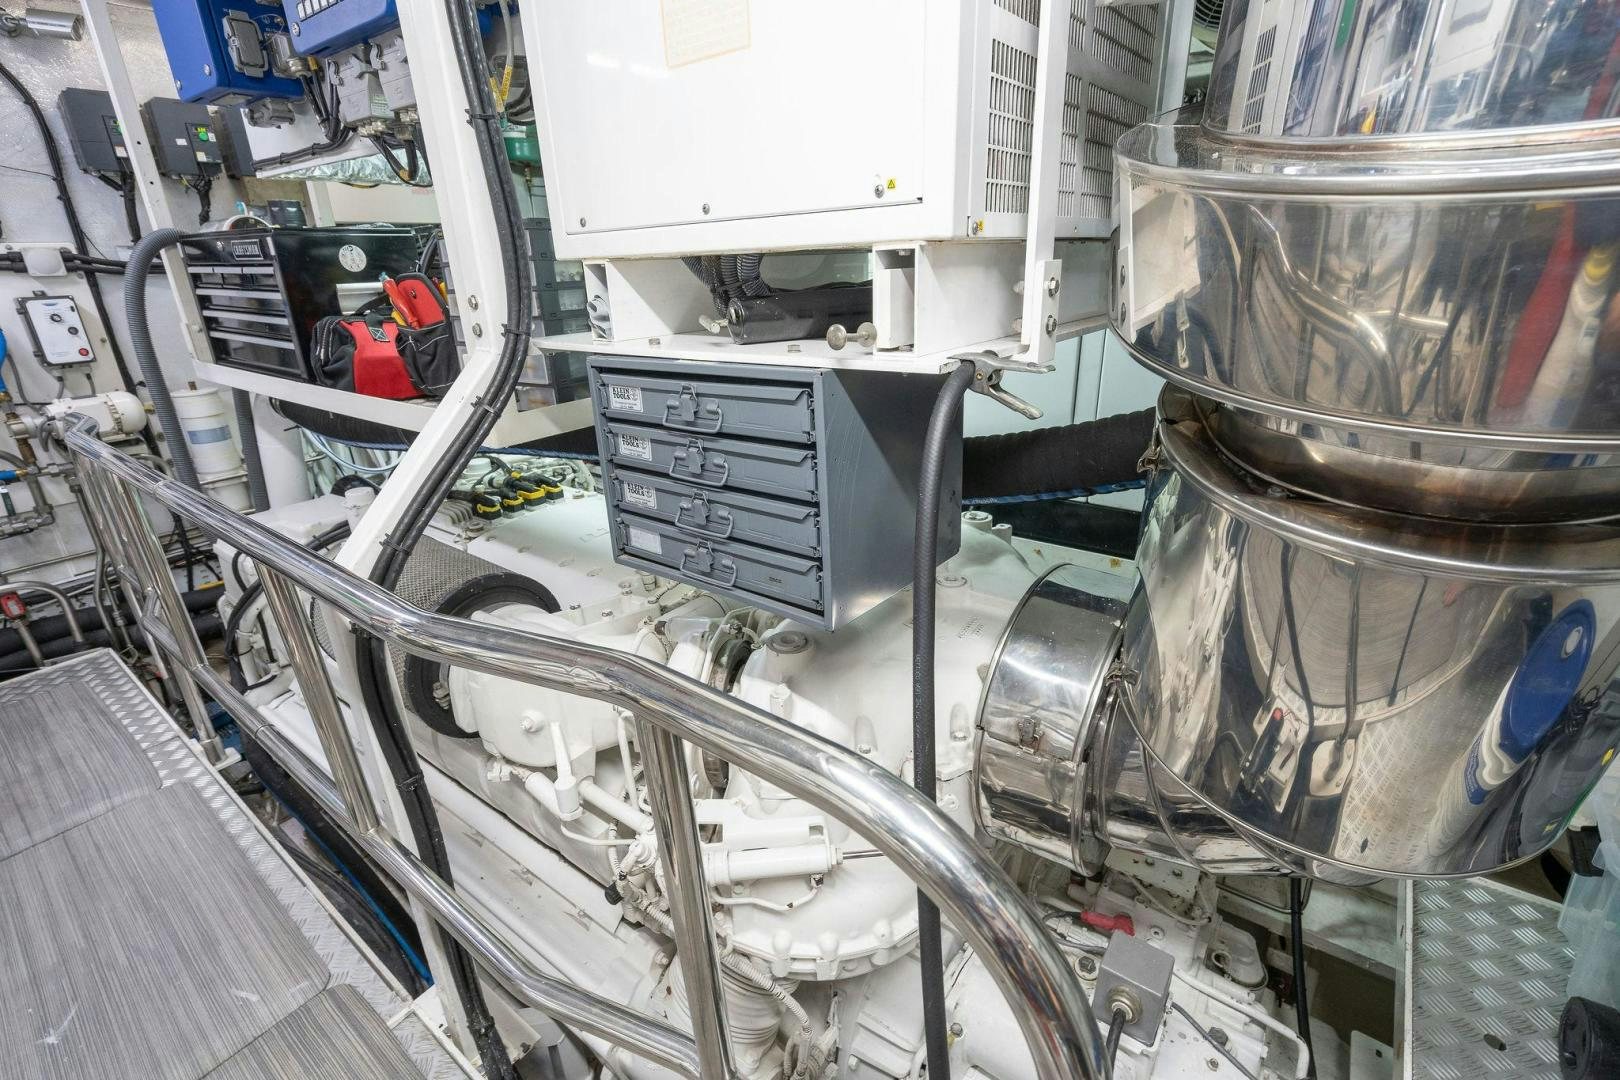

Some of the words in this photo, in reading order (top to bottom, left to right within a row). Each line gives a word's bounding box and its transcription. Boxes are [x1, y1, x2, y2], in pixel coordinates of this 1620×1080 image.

[612, 386, 630, 394] KLEIN
[612, 392, 631, 401] TOOLS
[621, 433, 639, 442] KLEIN
[622, 440, 640, 448] TOOLS
[627, 482, 644, 491] KLEIN
[628, 487, 645, 497] TOOLS
